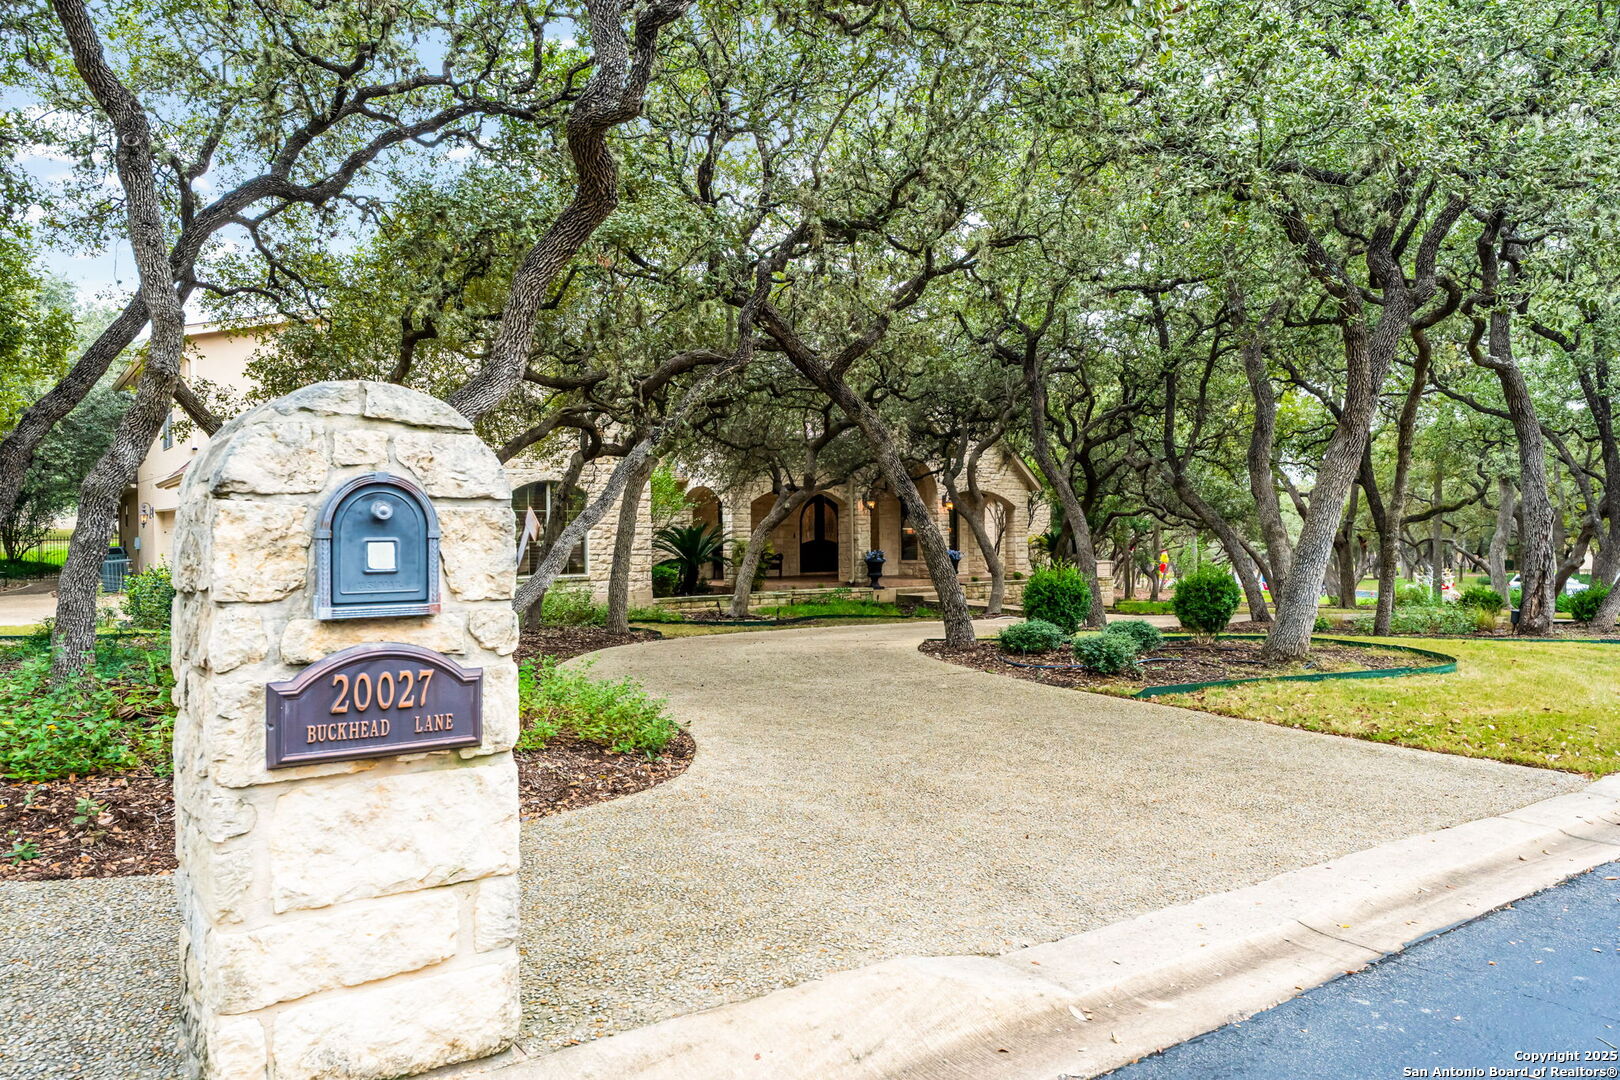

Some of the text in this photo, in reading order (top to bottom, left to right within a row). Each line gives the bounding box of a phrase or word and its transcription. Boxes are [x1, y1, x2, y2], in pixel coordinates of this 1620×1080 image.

[331, 668, 435, 714] 20027
[306, 713, 454, 743] BUCKHEAD LANE
